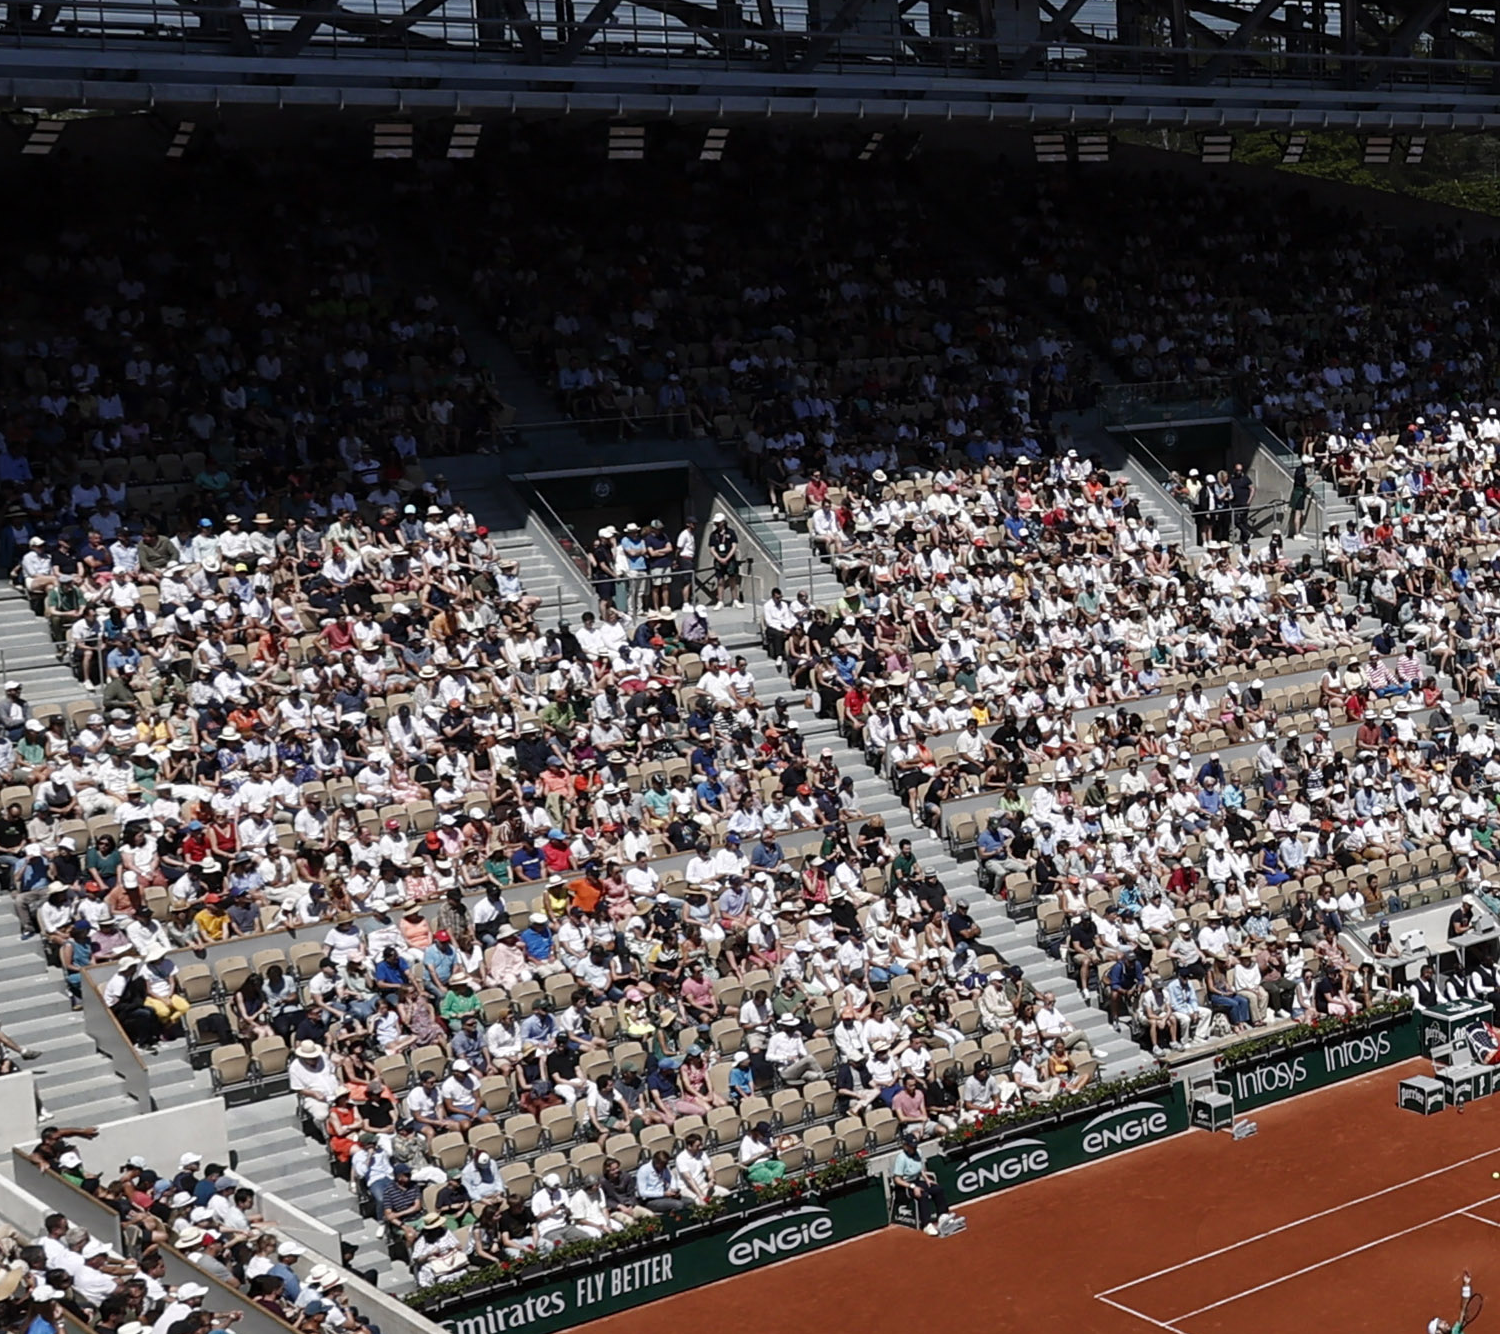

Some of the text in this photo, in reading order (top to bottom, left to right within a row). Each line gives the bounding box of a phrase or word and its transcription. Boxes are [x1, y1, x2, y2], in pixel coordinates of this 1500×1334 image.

[1324, 1030, 1392, 1073] Infosys
[1236, 1056, 1307, 1100] Infosys
[1400, 1086, 1425, 1108] perrier
[576, 1271, 606, 1308] FLY
[610, 1252, 674, 1298] BETTER
